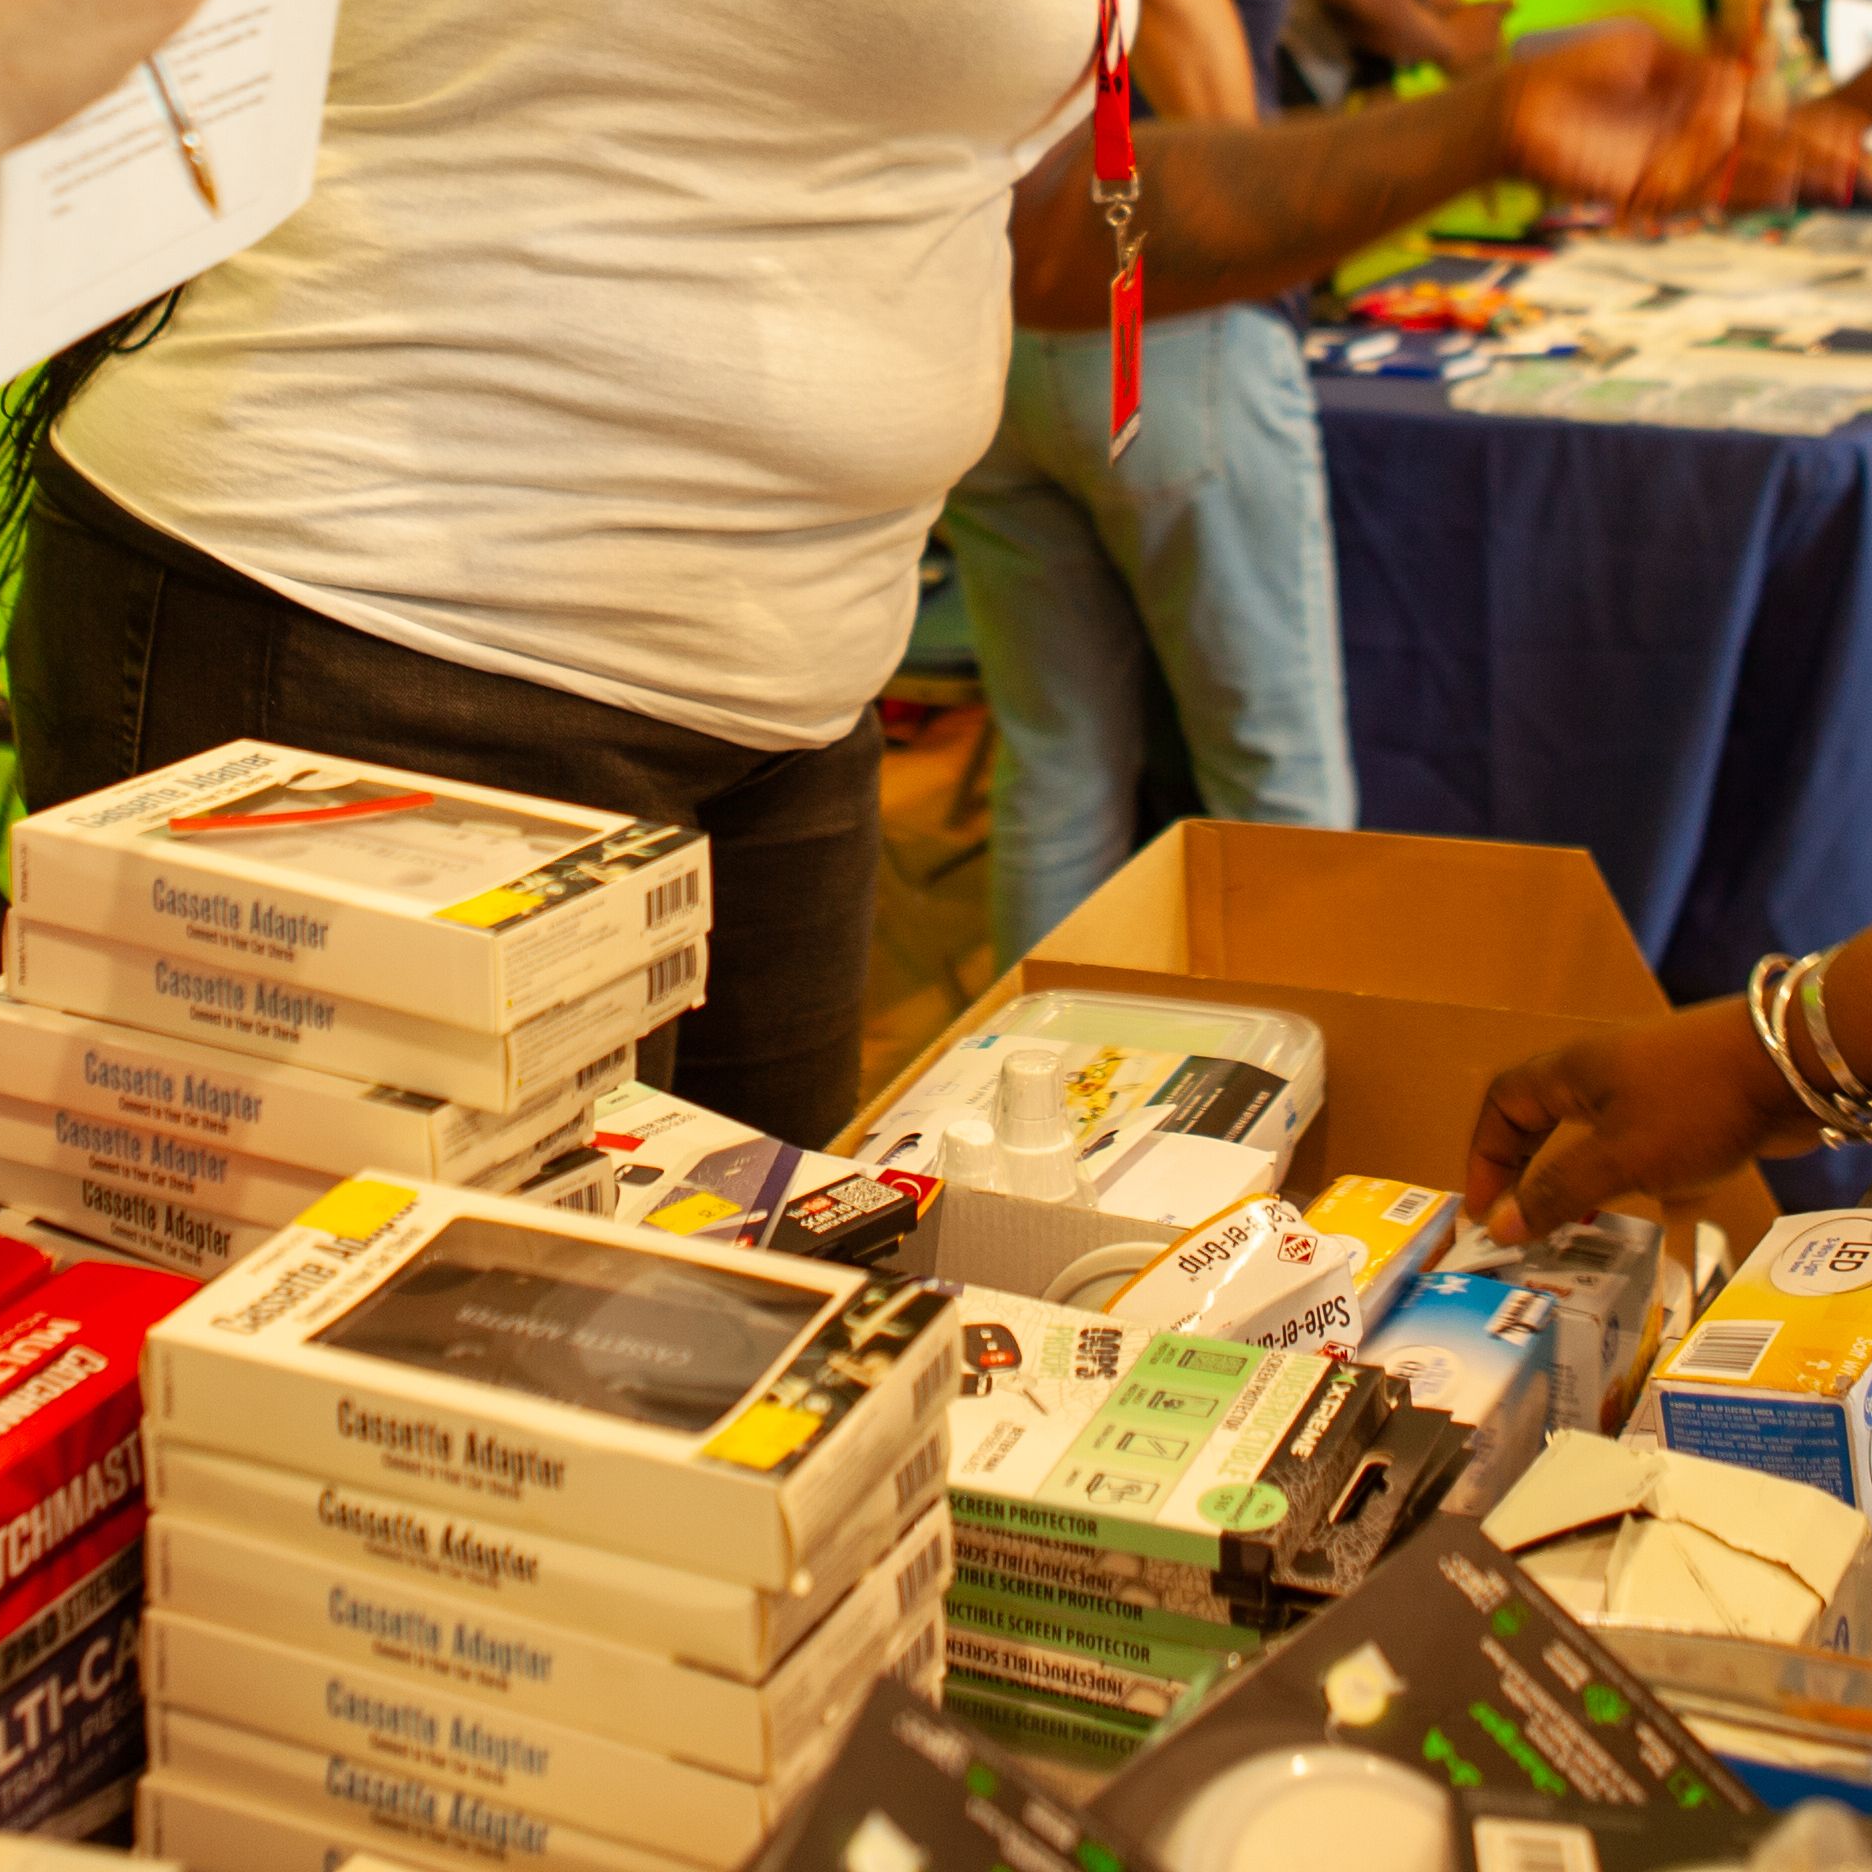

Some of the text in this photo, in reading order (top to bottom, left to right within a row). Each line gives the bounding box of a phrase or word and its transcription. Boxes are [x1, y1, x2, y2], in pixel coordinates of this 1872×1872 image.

[152, 879, 329, 950] Cassette Adapter
[155, 959, 335, 1032] Cassette Adapter
[84, 1050, 262, 1124] Cassette Adapter
[54, 1110, 228, 1185] Cassette Adapter
[82, 1178, 232, 1259] Cassette Adapter
[336, 1396, 453, 1463] Cassette
[463, 1429, 566, 1491] Adapter
[318, 1486, 428, 1555] Cassette
[440, 1522, 539, 1585] Adapter
[948, 1493, 1098, 1538] SCREEN PROTECTOR
[957, 1565, 1144, 1622] TIBLE SCREEN PROTECTOR
[328, 1584, 442, 1653] Cassette
[452, 1622, 553, 1684] Adapter
[946, 1599, 1151, 1664] UCTIBLE SCREEN PROTECTOR
[946, 1638, 999, 1665] SCREEN
[1001, 1650, 1124, 1695] INDESTRUCTIBLE
[325, 1679, 438, 1748] Cassette
[450, 1715, 549, 1777] Adapter
[324, 1753, 438, 1827] Cassette
[450, 1790, 549, 1855] Adapter
